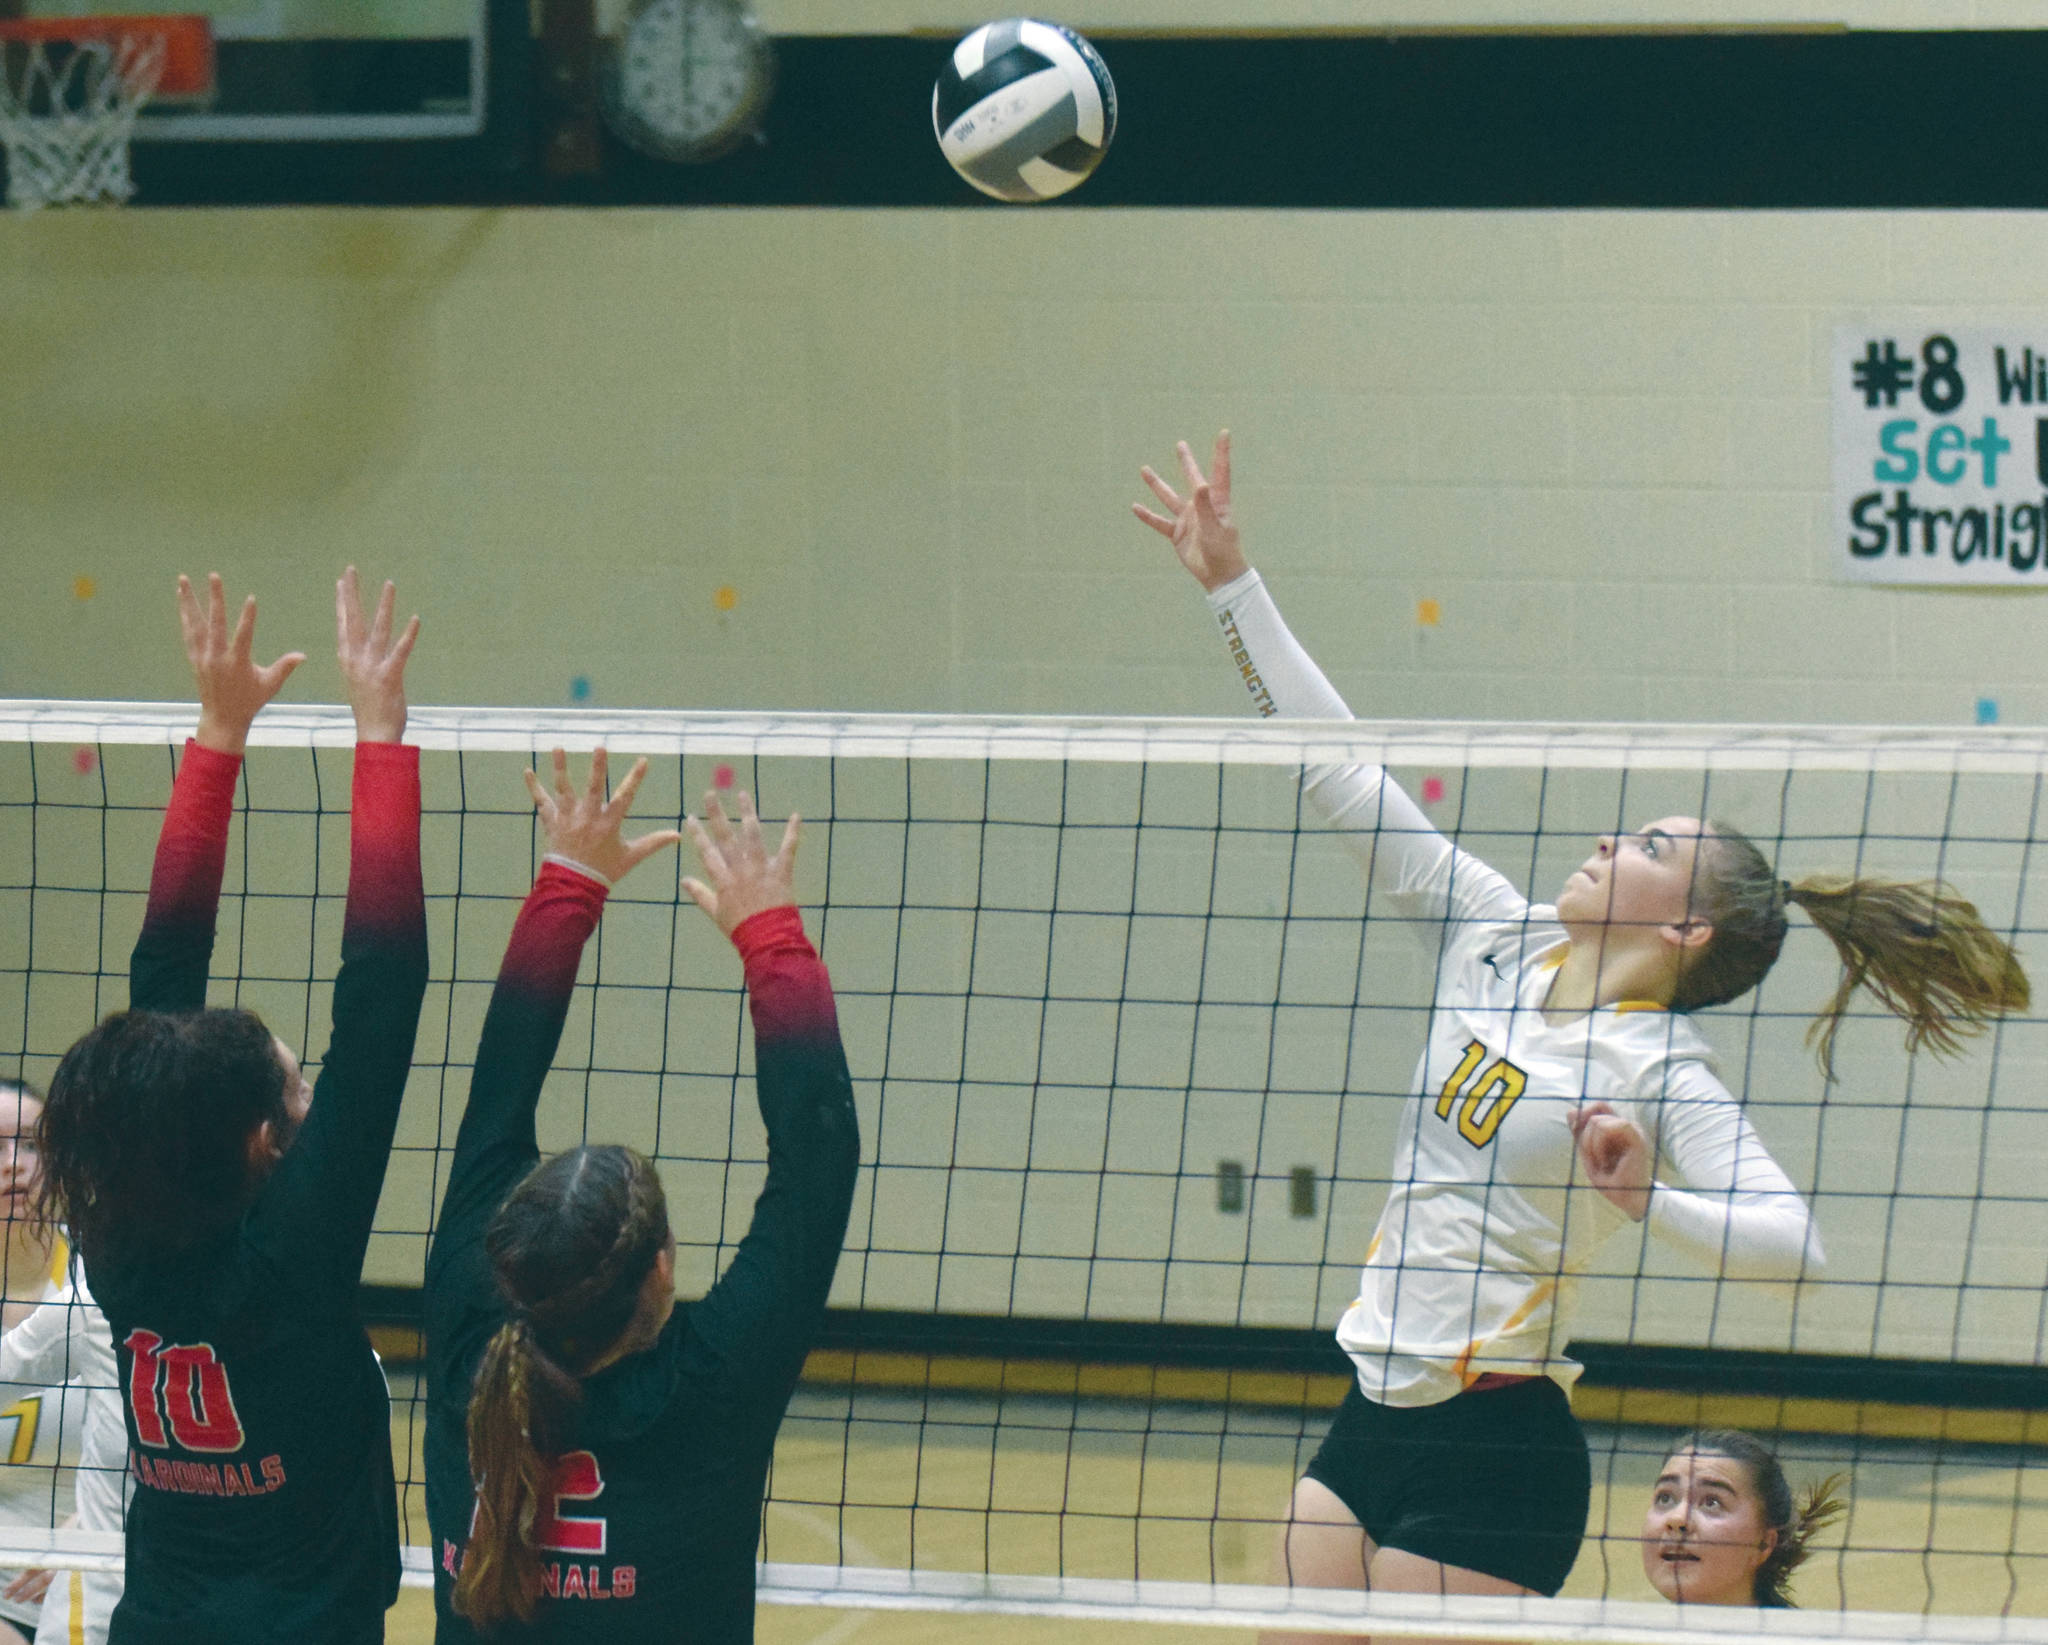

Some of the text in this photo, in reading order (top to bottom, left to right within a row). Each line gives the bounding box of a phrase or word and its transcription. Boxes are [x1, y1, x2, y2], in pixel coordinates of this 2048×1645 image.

[1852, 333, 1966, 415] #8
[1849, 489, 2048, 571] Straig
[1218, 608, 1278, 719] STRENGTH
[1435, 1038, 1529, 1150] 10
[123, 1328, 246, 1454] 10
